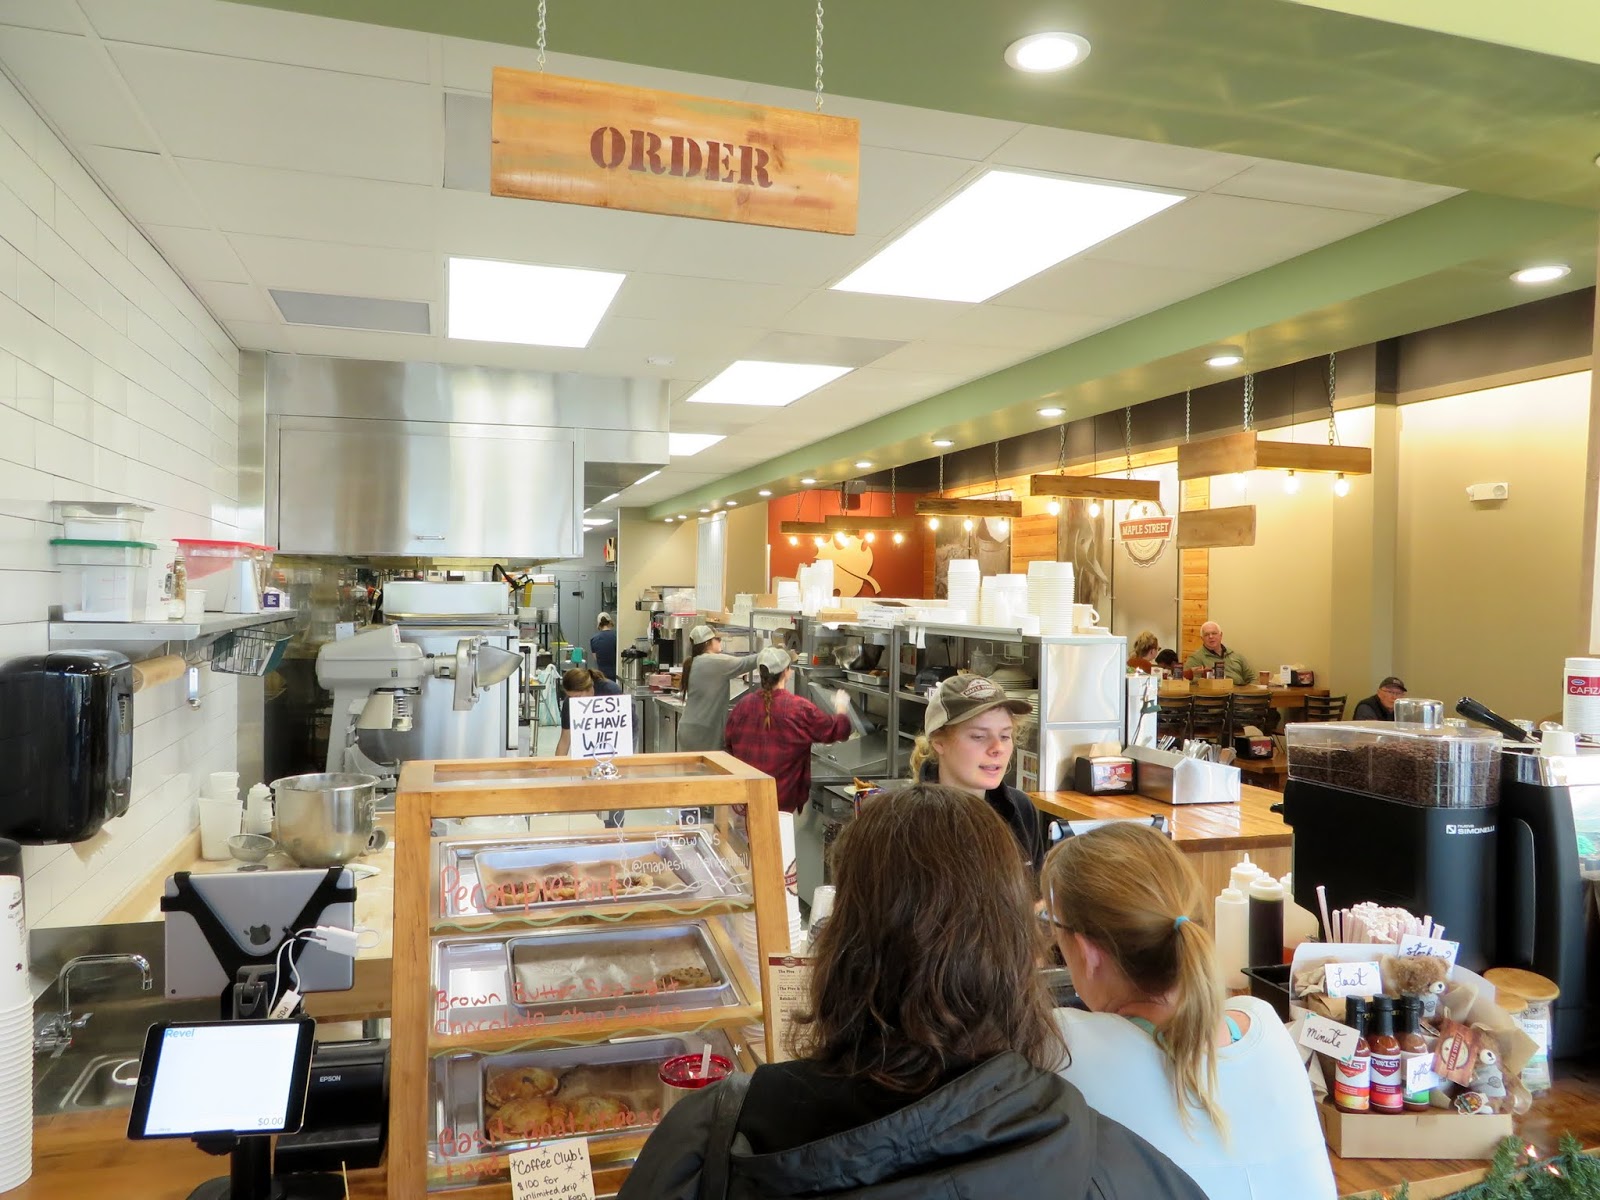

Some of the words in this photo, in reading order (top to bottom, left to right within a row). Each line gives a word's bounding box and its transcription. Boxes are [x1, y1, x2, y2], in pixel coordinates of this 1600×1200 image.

[590, 126, 773, 189] ORDER
[1122, 524, 1144, 536] MAPLE
[1144, 522, 1170, 534] STREET
[578, 697, 620, 714] YES!
[573, 717, 593, 730] WE
[595, 714, 627, 729] HAVE
[582, 731, 618, 750] WIFI
[1458, 825, 1495, 835] SIMONELLI
[441, 866, 517, 915] Pecan
[435, 989, 501, 1011] Brown
[165, 1028, 194, 1039] Revel
[1307, 1027, 1348, 1049] minute
[258, 1117, 283, 1126] $0.00
[517, 1158, 552, 1175] Coffee
[554, 1147, 584, 1165] Club!
[517, 1180, 539, 1191] $100
[543, 1176, 559, 1185] for
[561, 1182, 577, 1193] drip
